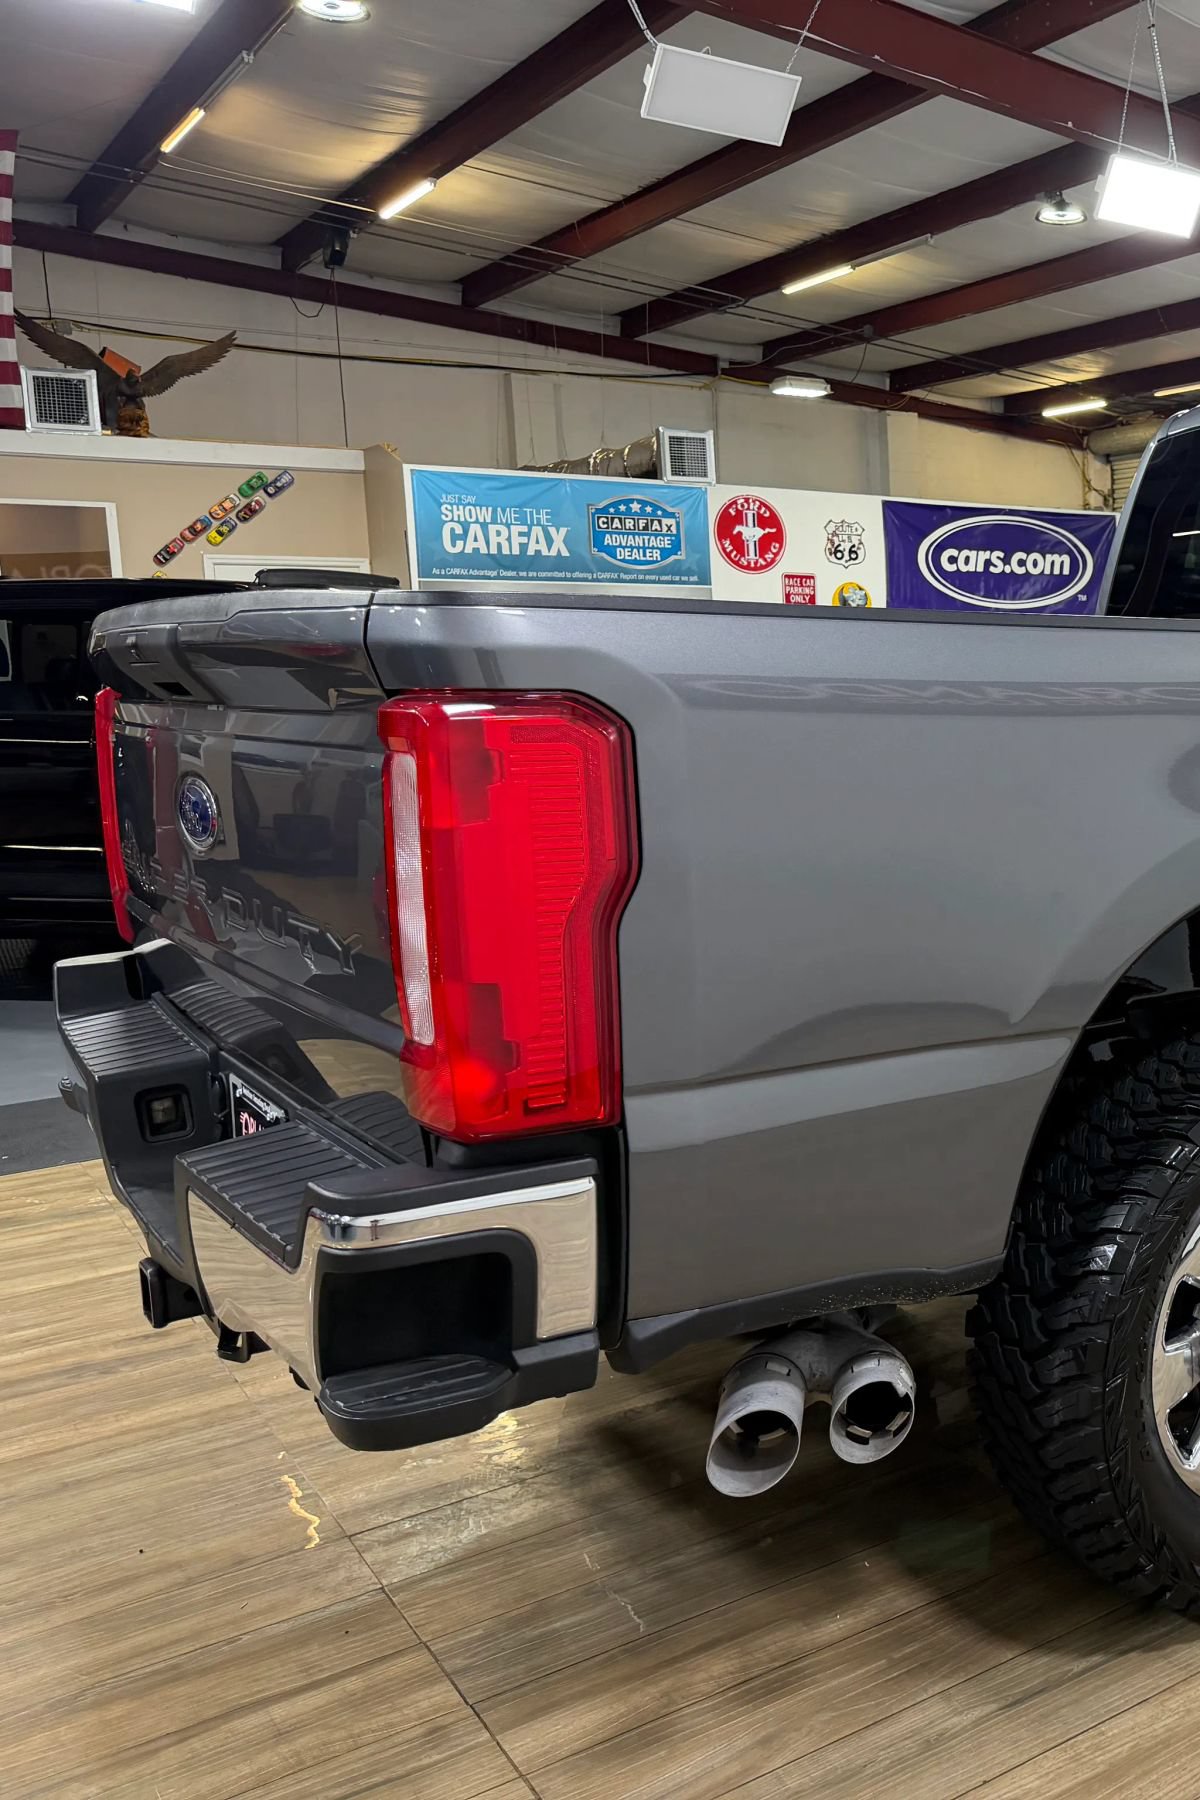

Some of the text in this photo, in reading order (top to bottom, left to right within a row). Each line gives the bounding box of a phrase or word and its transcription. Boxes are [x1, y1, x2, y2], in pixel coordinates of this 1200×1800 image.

[440, 494, 476, 504] JUST SAY
[440, 504, 552, 526] SHOW ME THE
[728, 498, 771, 518] FORD
[597, 516, 674, 533] CARFAX
[441, 521, 571, 557] CARFAX
[616, 547, 661, 561] DEALER
[721, 538, 780, 568] MUSTANG
[833, 543, 859, 561] 66
[940, 548, 1071, 576] cars.com
[785, 577, 814, 587] RACE CAR
[785, 586, 815, 595] PARKING
[789, 595, 811, 604] ONLY
